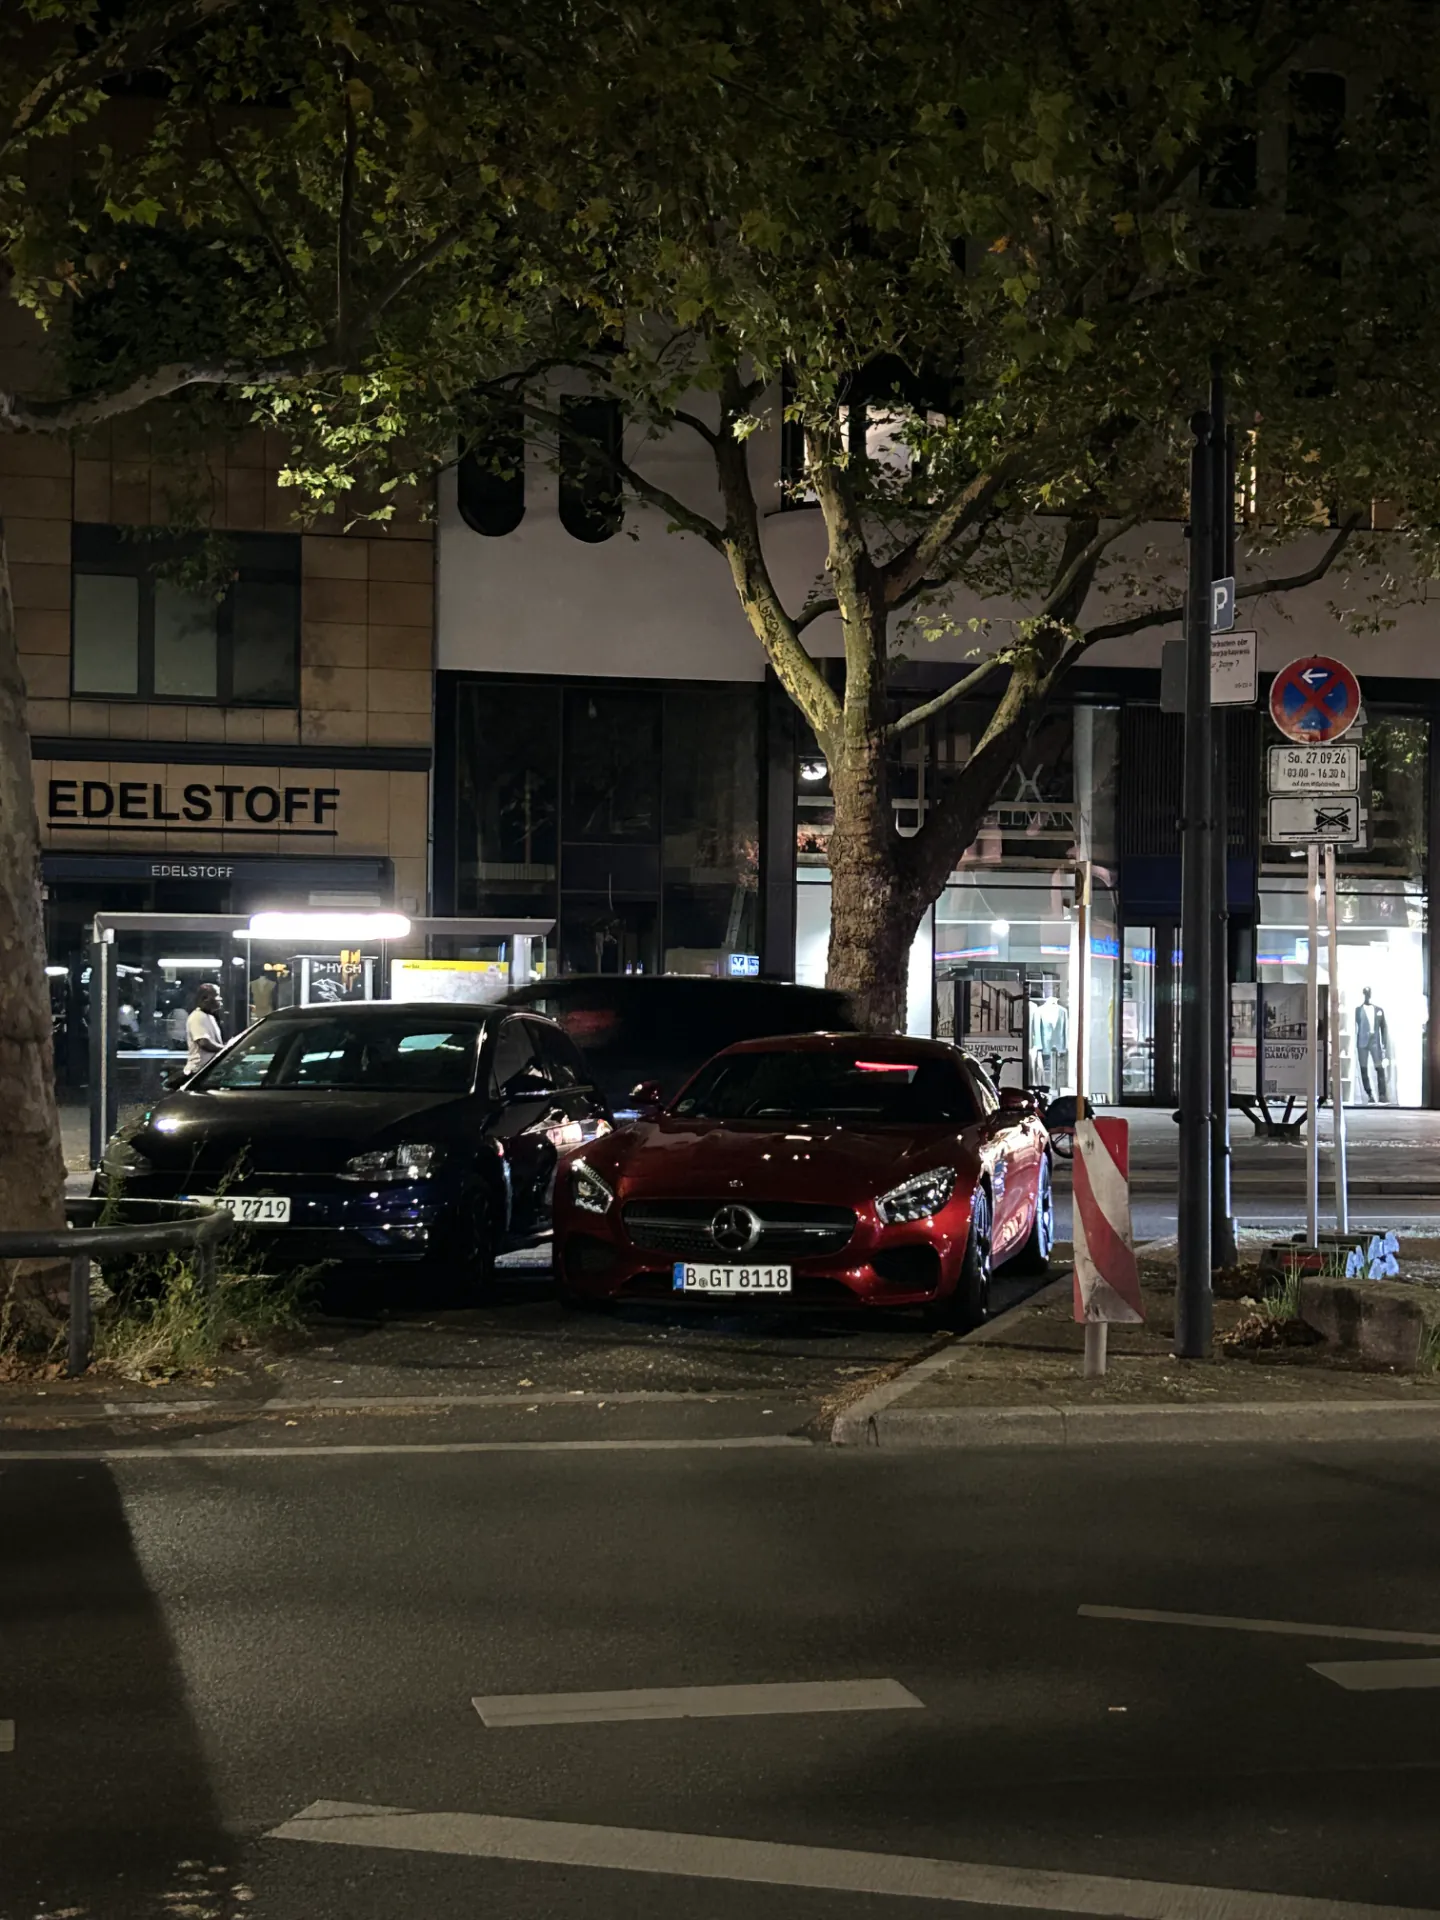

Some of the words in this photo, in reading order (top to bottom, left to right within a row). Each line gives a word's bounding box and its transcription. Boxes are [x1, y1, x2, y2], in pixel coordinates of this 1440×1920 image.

[1213, 586, 1228, 625] P
[1306, 751, 1346, 765] 27.09.26
[49, 779, 340, 825] EDELSTOFF
[983, 809, 1090, 830] ELLMANN
[151, 865, 234, 878] EDELSTOFF
[326, 963, 362, 974] HYGH
[241, 1199, 287, 1219] 7719
[685, 1267, 697, 1286] B
[710, 1268, 734, 1288] GT
[739, 1268, 788, 1289] 8118
